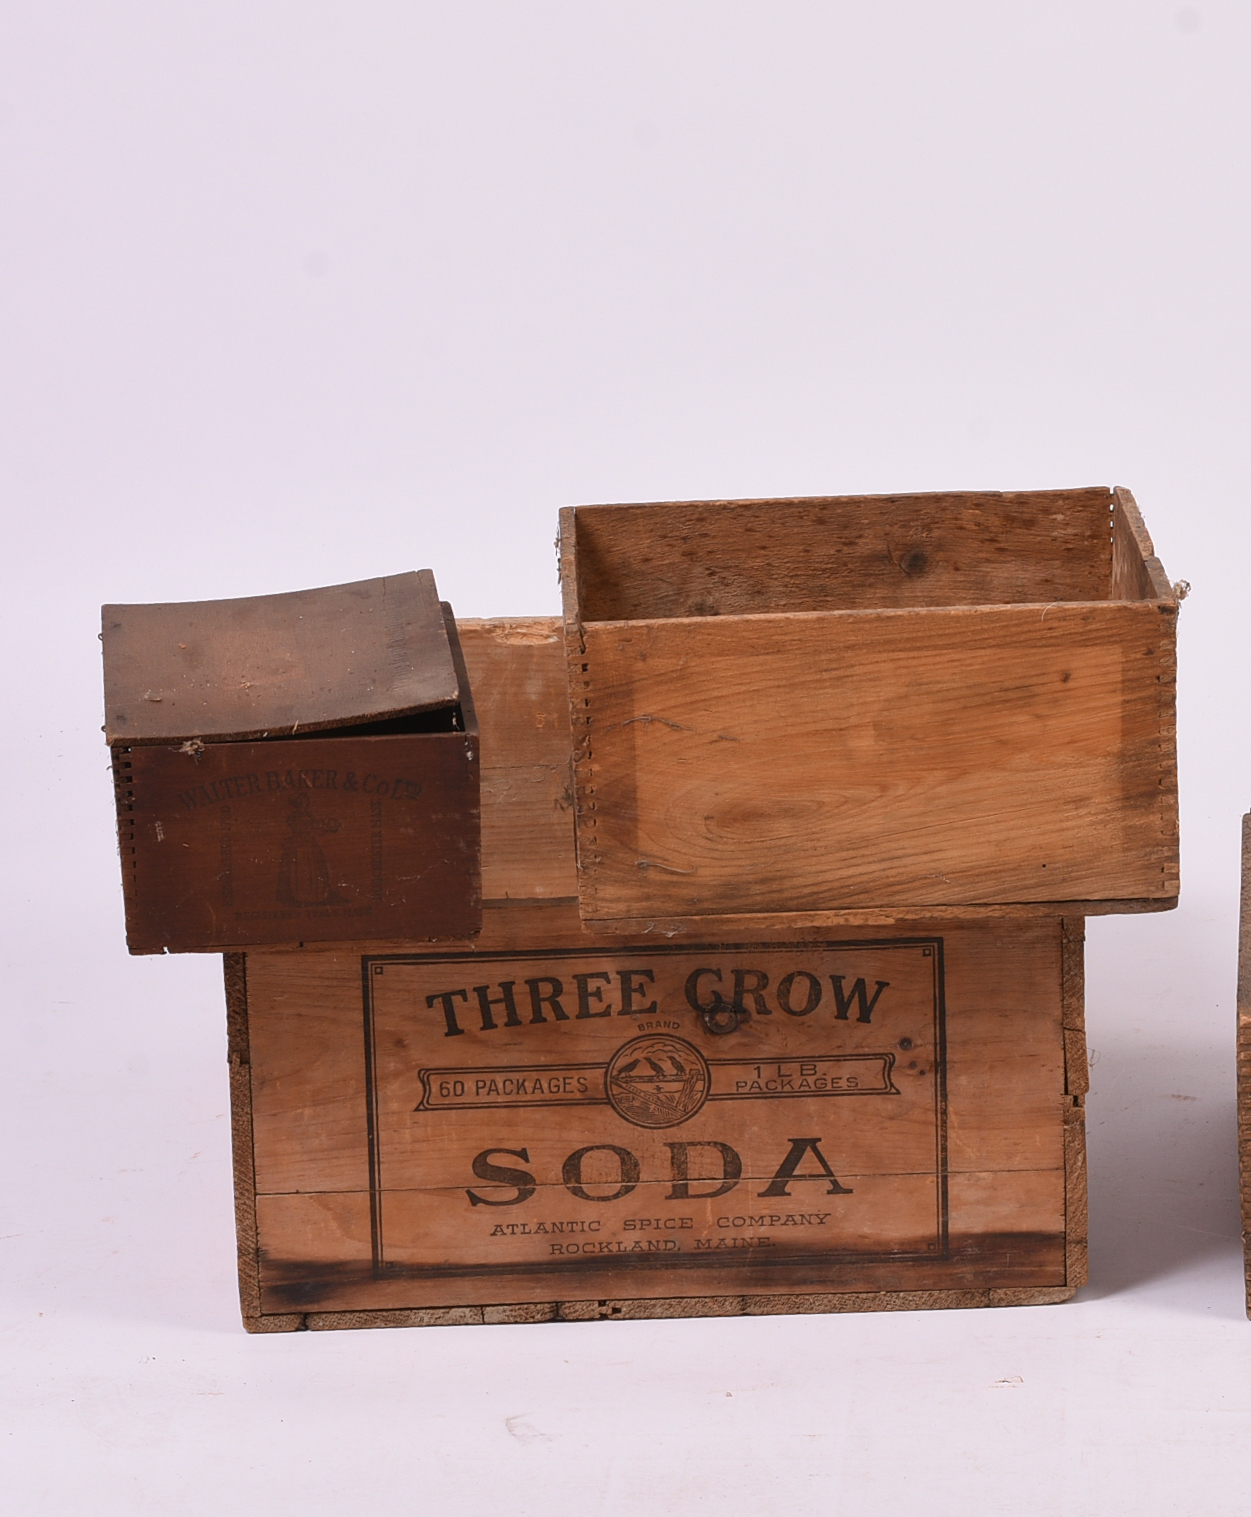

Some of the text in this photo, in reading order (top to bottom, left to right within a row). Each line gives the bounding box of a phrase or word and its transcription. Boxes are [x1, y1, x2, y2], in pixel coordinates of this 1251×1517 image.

[177, 773, 262, 811] WALTER
[264, 768, 338, 792] BAKER
[342, 771, 359, 792] &
[425, 968, 658, 1038] THREE
[637, 1020, 681, 1032] BRAND
[735, 1076, 859, 1092] PACKAGES
[753, 1065, 762, 1079] 1
[439, 1074, 590, 1098] 60 PACKAGES
[464, 1136, 854, 1208] SODA
[490, 1212, 832, 1236] ATLANTIC SPICE COMPANY
